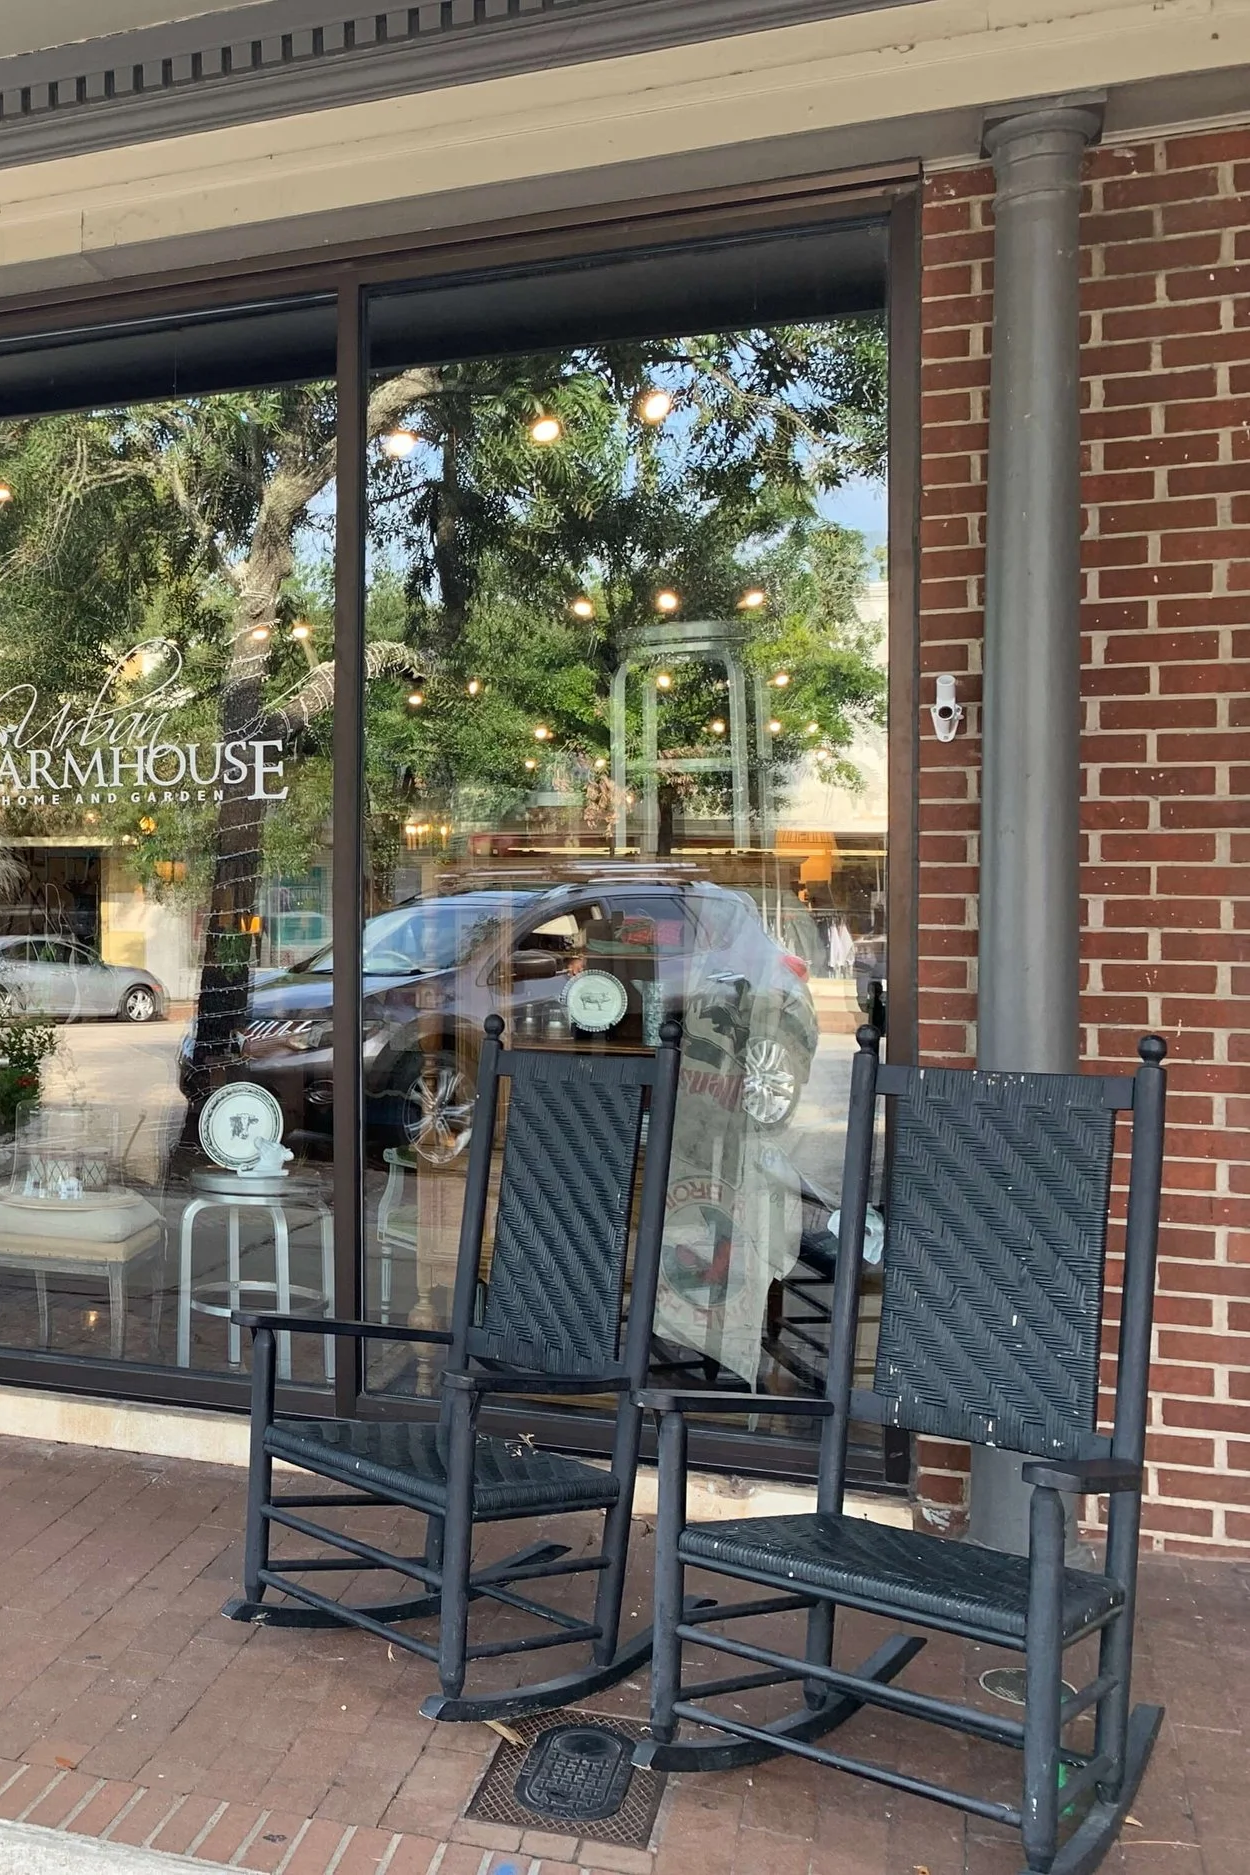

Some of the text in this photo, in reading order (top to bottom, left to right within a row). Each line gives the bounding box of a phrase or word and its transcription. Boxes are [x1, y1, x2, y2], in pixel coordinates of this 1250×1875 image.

[1, 789, 225, 806] HOME AND GARDEN
